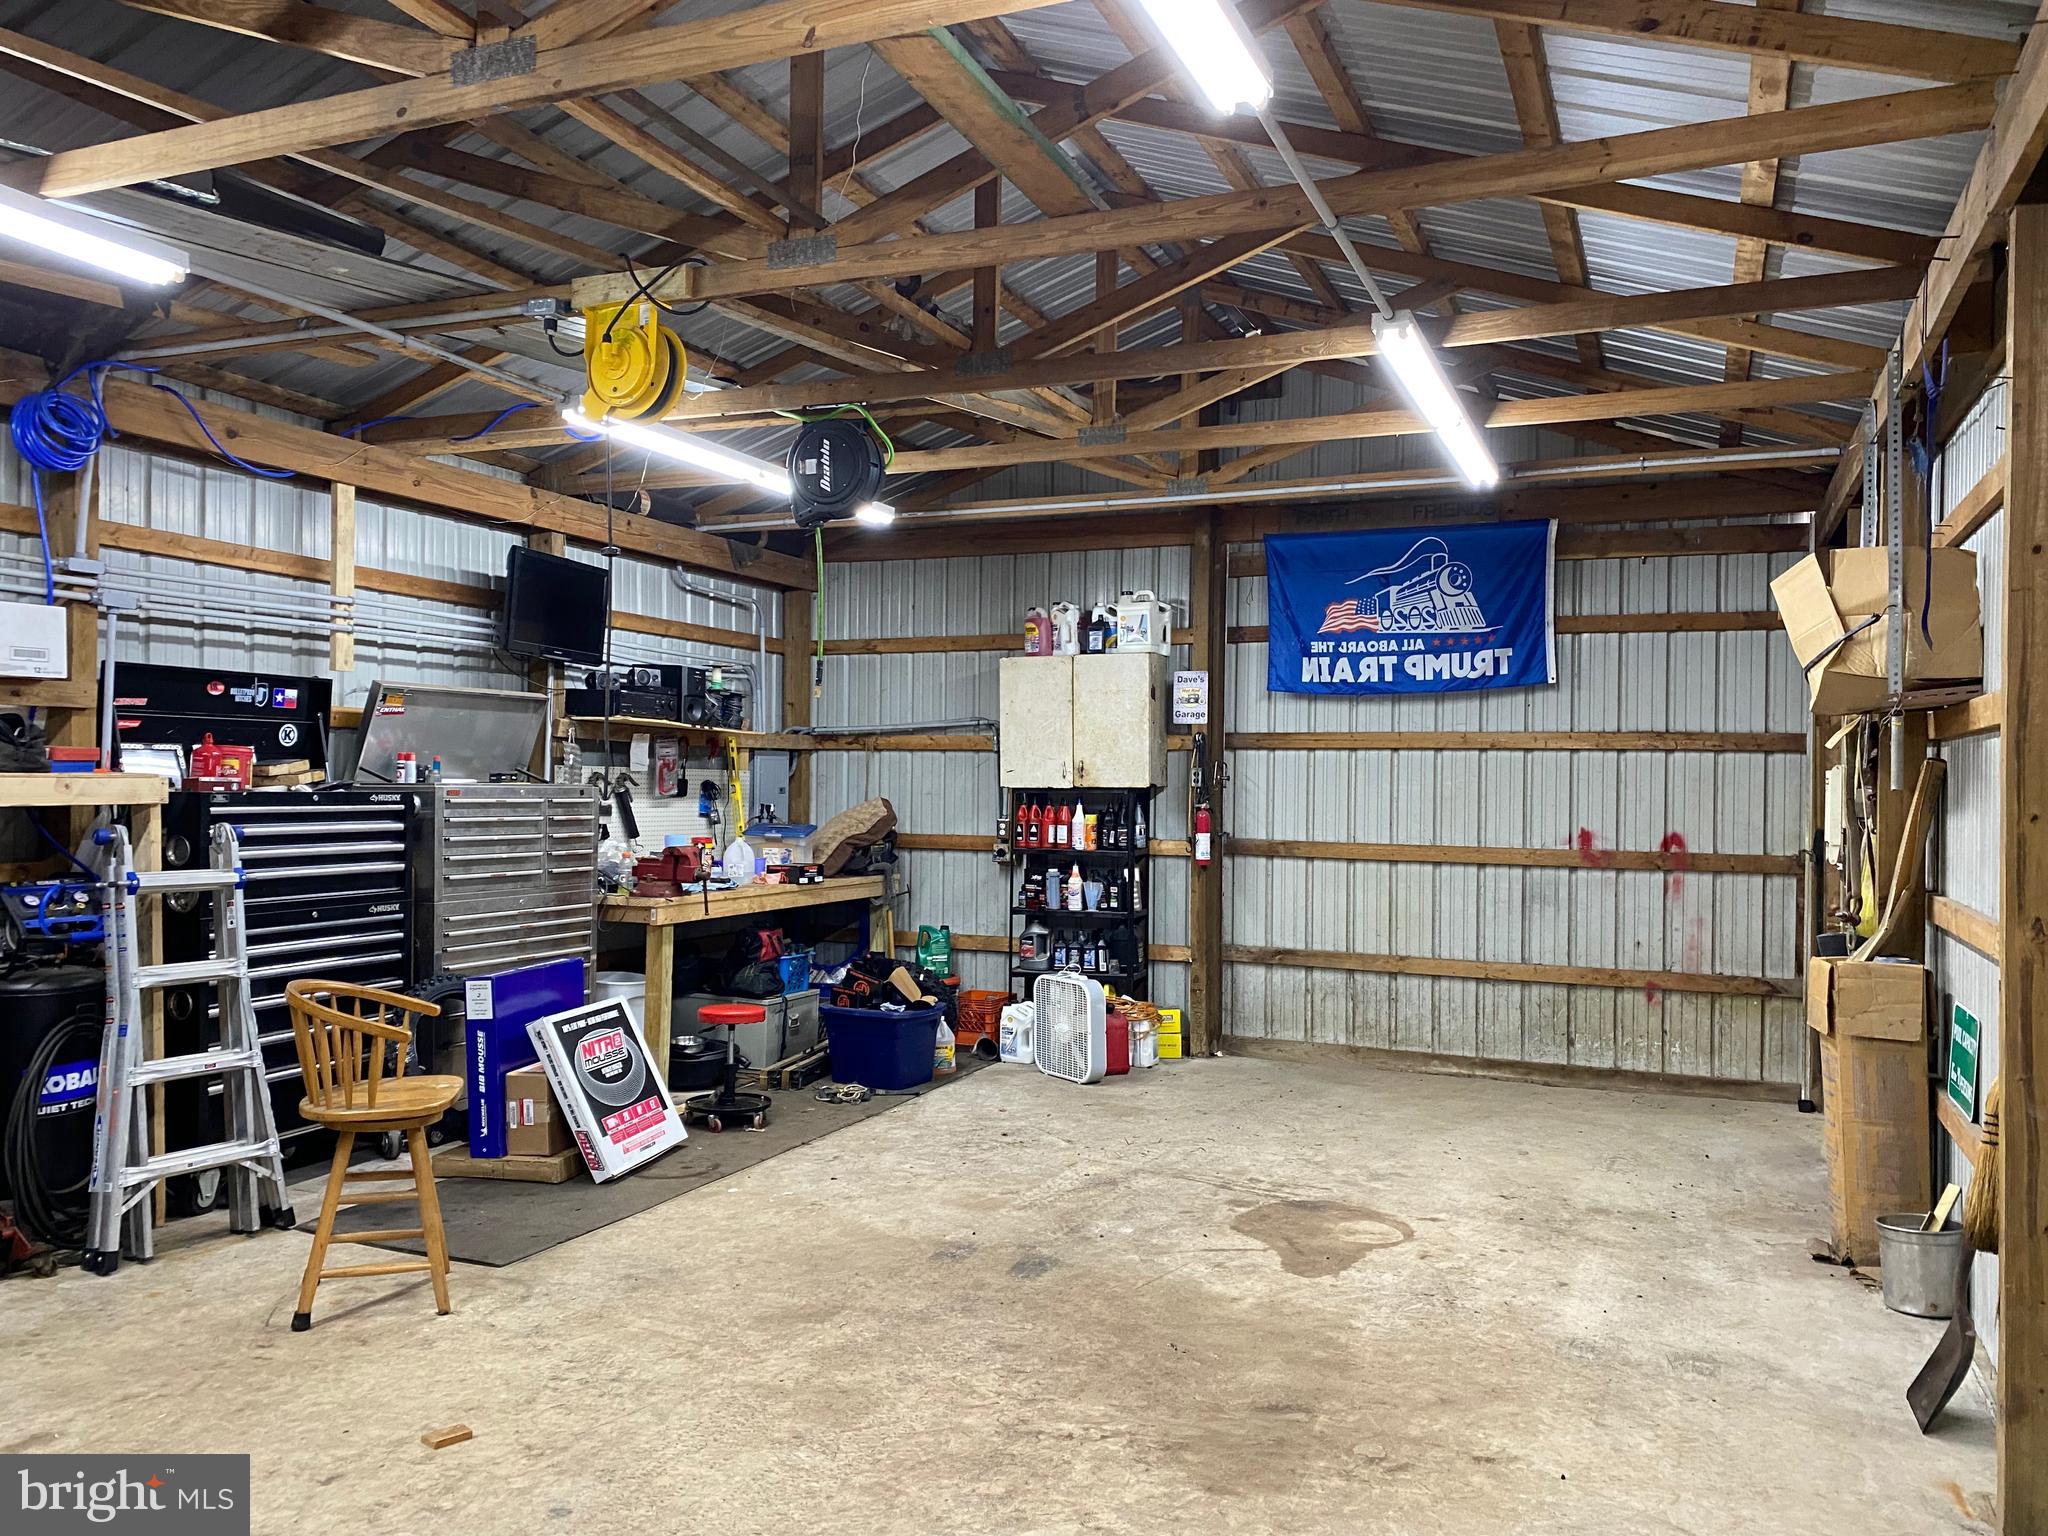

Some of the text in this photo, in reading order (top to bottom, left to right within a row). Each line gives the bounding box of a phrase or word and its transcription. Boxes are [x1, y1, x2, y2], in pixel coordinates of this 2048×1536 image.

[1177, 675, 1205, 684] Dave's
[1175, 711, 1206, 720] Garage
[378, 794, 401, 802] HUSKY
[377, 904, 400, 912] HUSKY
[477, 1030, 486, 1093] BIB MOUSSE
[585, 1047, 625, 1068] MOUSSE
[37, 1096, 97, 1115] UIET TEC
